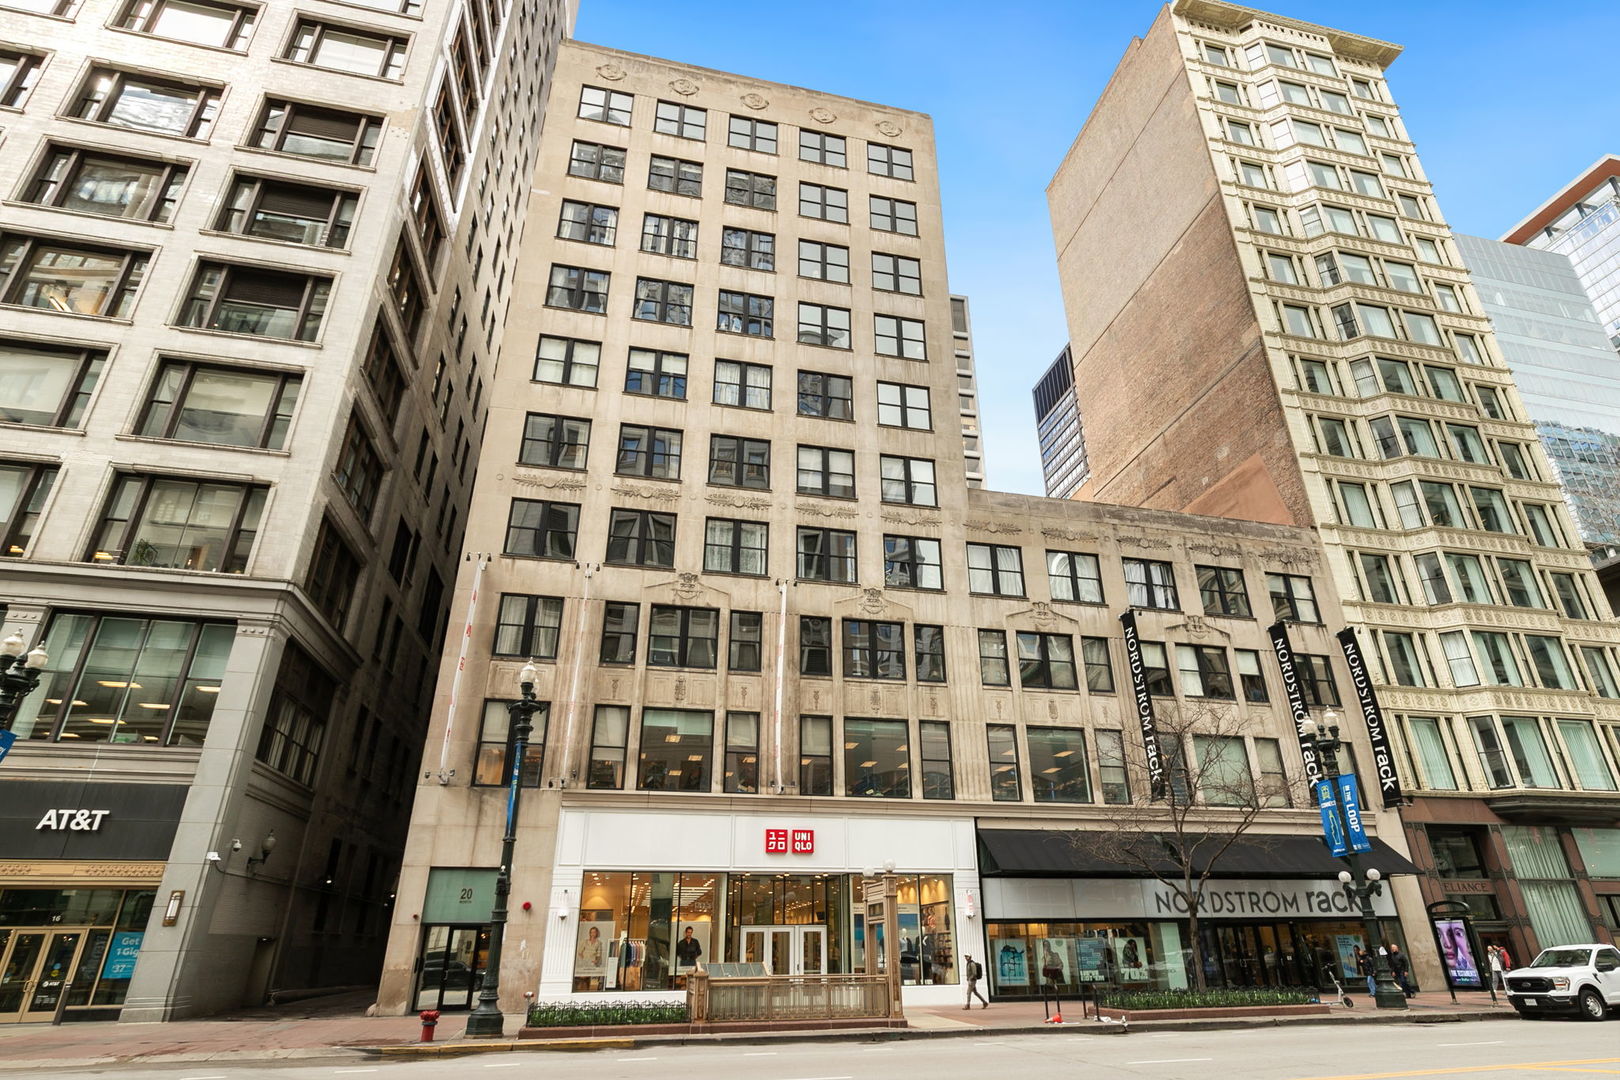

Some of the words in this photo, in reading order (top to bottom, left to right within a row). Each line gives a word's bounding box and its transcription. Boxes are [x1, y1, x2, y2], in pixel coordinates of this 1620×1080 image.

[1124, 626, 1153, 731] NORDSTROM
[1145, 735, 1163, 784] rack
[1344, 642, 1382, 742] NORDSTROM
[1374, 745, 1397, 792] rack
[1301, 742, 1323, 789] rack
[35, 809, 110, 831] AT&T
[1346, 803, 1360, 833] LOOP
[768, 831, 786, 841] ユニ
[768, 841, 786, 850] クロ
[460, 888, 473, 900] 20
[1443, 882, 1489, 892] ELIANCE
[1154, 890, 1301, 914] NORDSTROM
[1306, 885, 1363, 913] rack
[121, 937, 140, 945] Get
